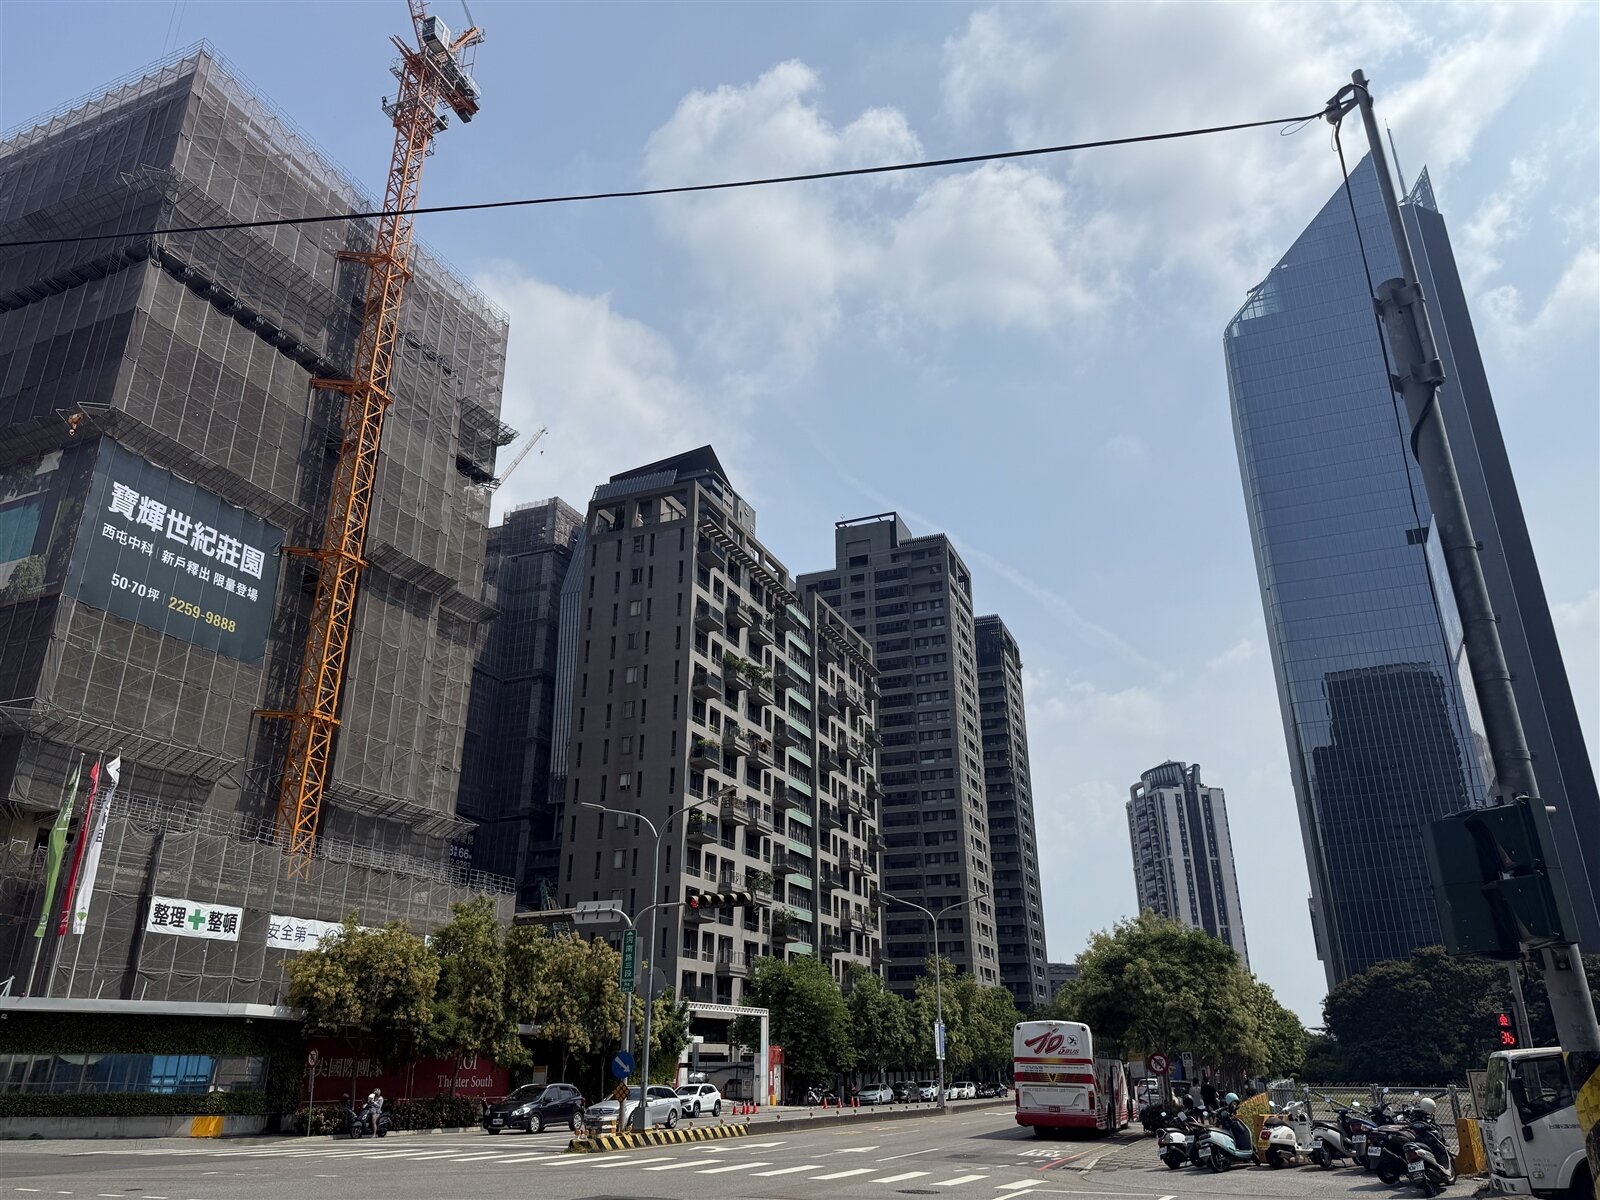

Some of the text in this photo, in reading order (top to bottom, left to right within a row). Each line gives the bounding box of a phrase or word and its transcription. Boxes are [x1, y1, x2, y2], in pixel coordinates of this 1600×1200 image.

[107, 481, 265, 580] 寶輝世紀莊園
[101, 522, 259, 602] 西屯中科 新戶釋出 限量登場
[167, 596, 237, 633] 2259-9888
[152, 903, 239, 936] 整理 整頓
[266, 921, 320, 943] 安全第一
[470, 1074, 493, 1088] South
